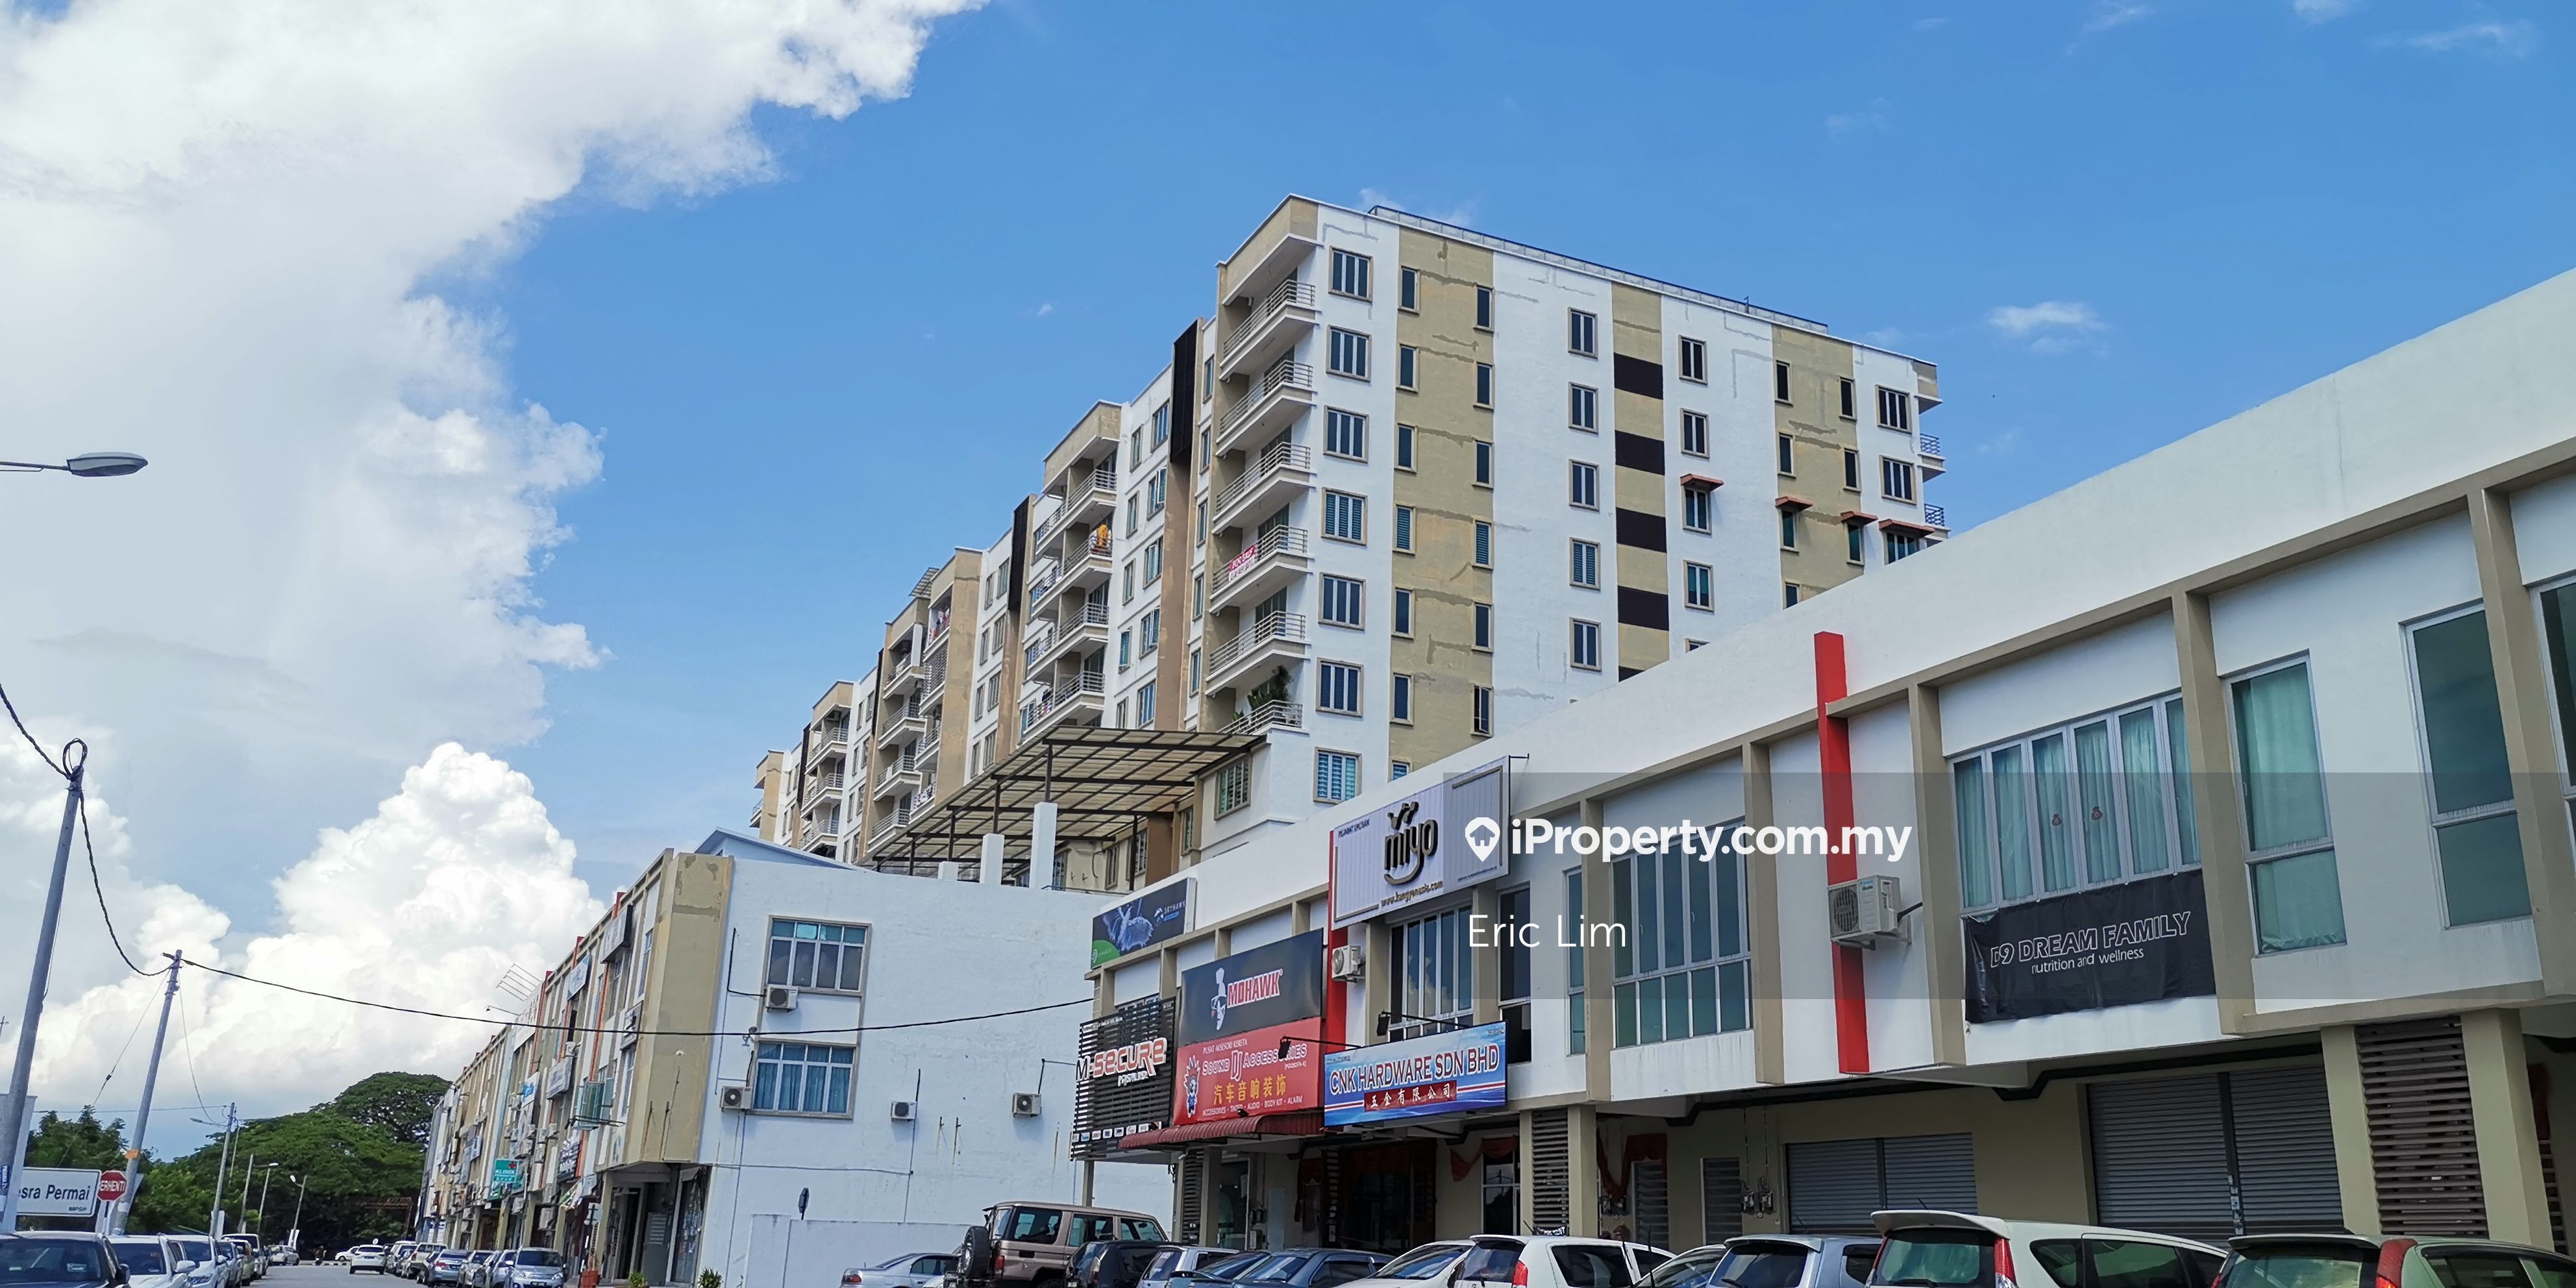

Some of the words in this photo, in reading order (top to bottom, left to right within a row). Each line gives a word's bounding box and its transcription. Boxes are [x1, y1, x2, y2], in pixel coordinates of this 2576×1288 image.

[2018, 928, 2098, 963] DREAM
[2103, 911, 2191, 948] FAMILY
[2031, 959, 2075, 974] nutrition
[2077, 953, 2094, 967] and
[2099, 947, 2144, 965] wellness
[1227, 970, 1280, 1009] MOHAWK
[1202, 1058, 1230, 1076] SOUND
[1243, 1043, 1307, 1069] ACCESSRIES
[1330, 1069, 1356, 1096] CNK
[1357, 1055, 1433, 1091] HARDWARE
[1434, 1050, 1465, 1082] SDN
[1467, 1043, 1500, 1076] BHD
[1213, 1073, 1287, 1105] 汽车音响装饰
[1247, 1101, 1260, 1110] AUDIO
[1287, 1095, 1303, 1105] ALARM
[1370, 1082, 1451, 1108] 五金有限公司
[45, 1185, 90, 1200] Permai
